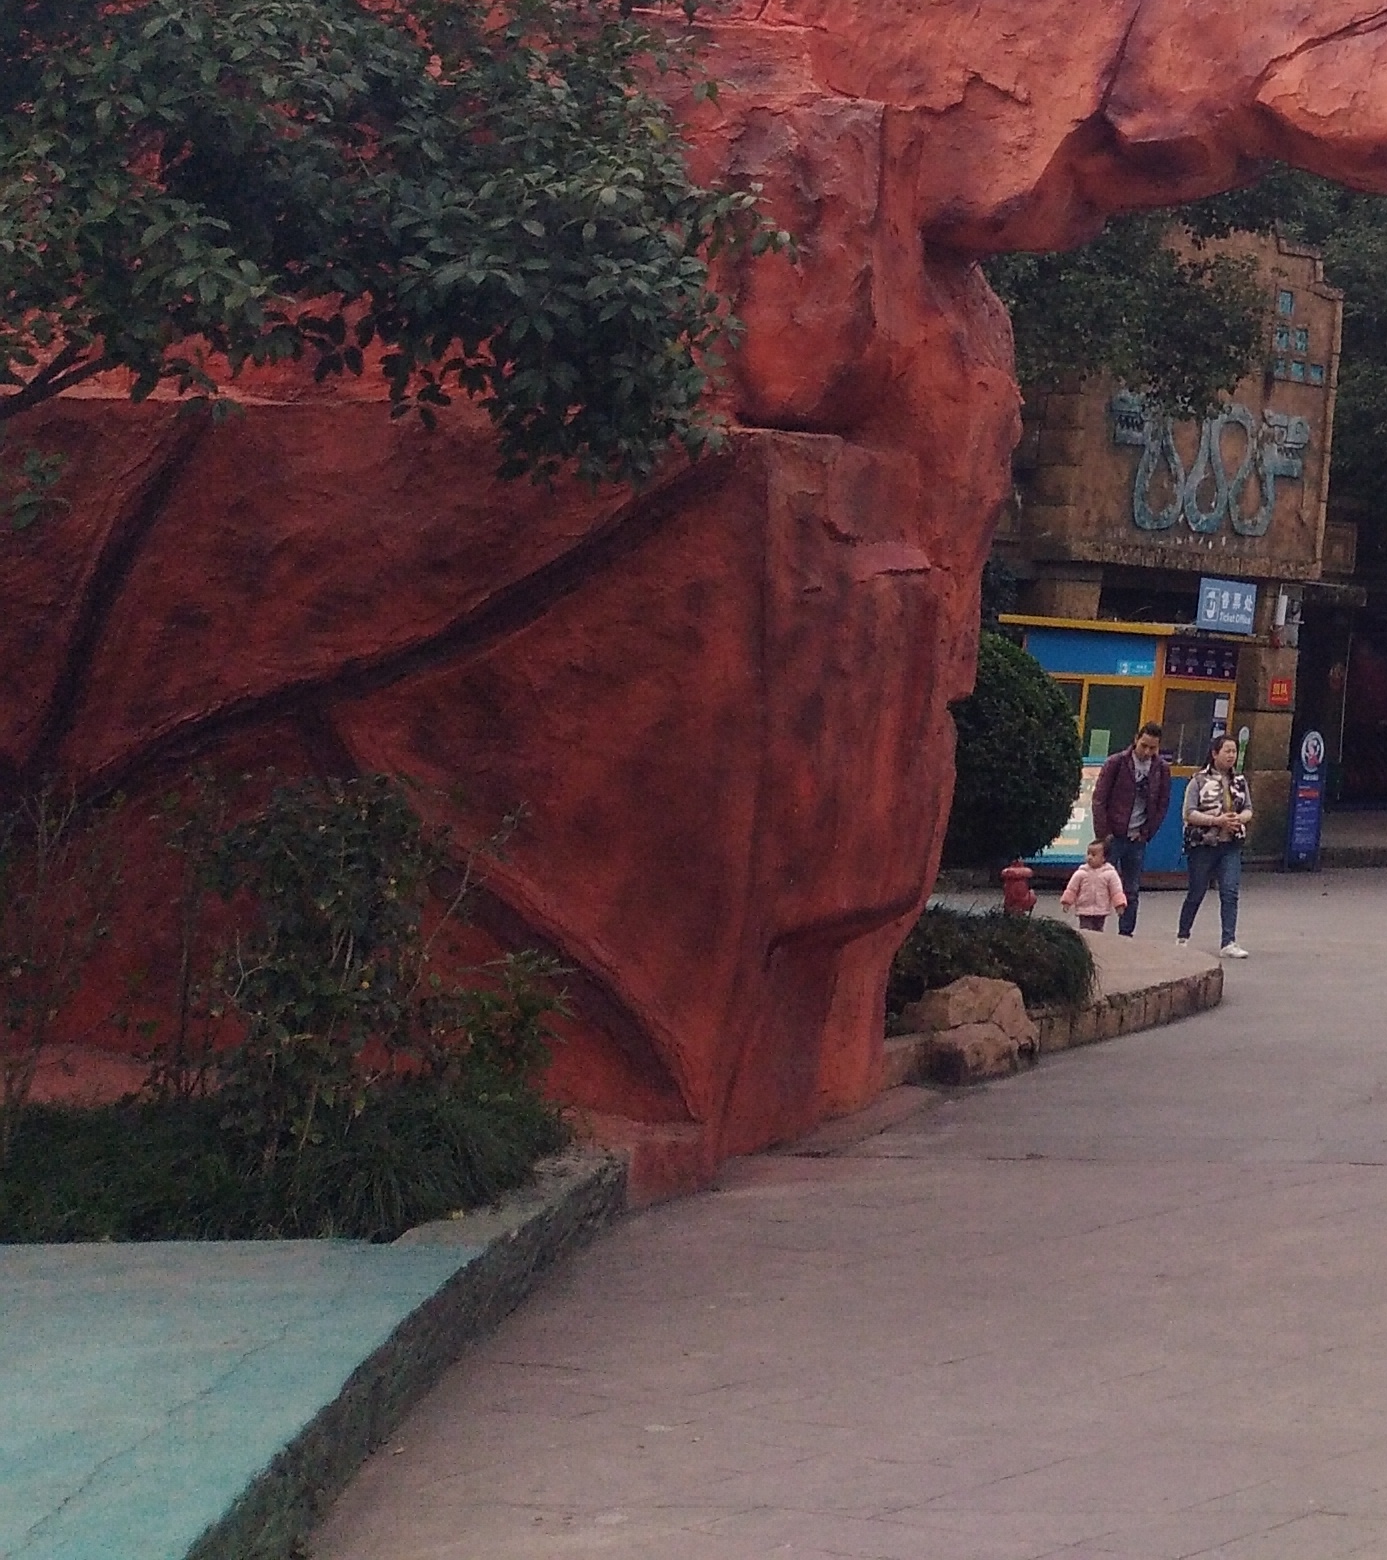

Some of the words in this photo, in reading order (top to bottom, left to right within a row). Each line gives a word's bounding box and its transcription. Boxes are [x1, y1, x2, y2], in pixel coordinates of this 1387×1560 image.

[1221, 591, 1253, 612] 售票处
[1219, 611, 1235, 623] Ticket
[1236, 613, 1251, 625] Office
